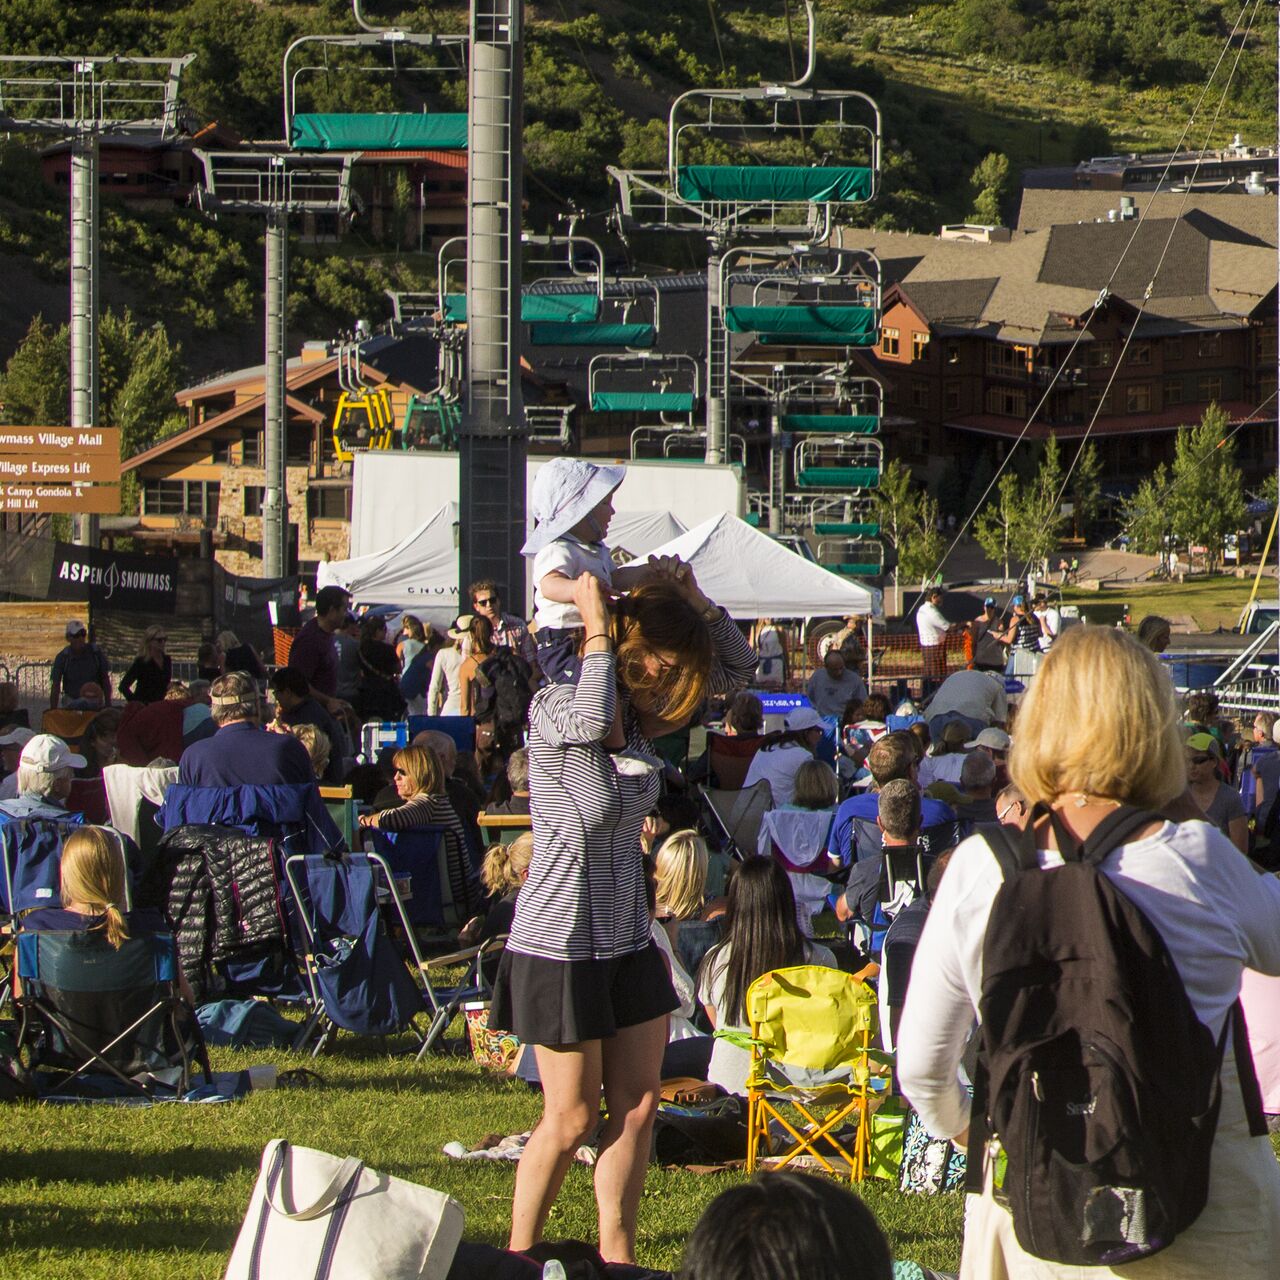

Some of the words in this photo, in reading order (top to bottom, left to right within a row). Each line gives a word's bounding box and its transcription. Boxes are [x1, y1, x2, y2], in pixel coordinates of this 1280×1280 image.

[38, 432, 74, 448] Village
[78, 433, 103, 446] Mall
[32, 461, 70, 476] Express
[74, 462, 91, 474] Lift
[7, 487, 33, 498] Camp
[36, 487, 72, 497] Gondola
[75, 487, 84, 497] &
[7, 498, 22, 509] Hill
[24, 499, 39, 509] Lift
[59, 561, 102, 585] ASPEN
